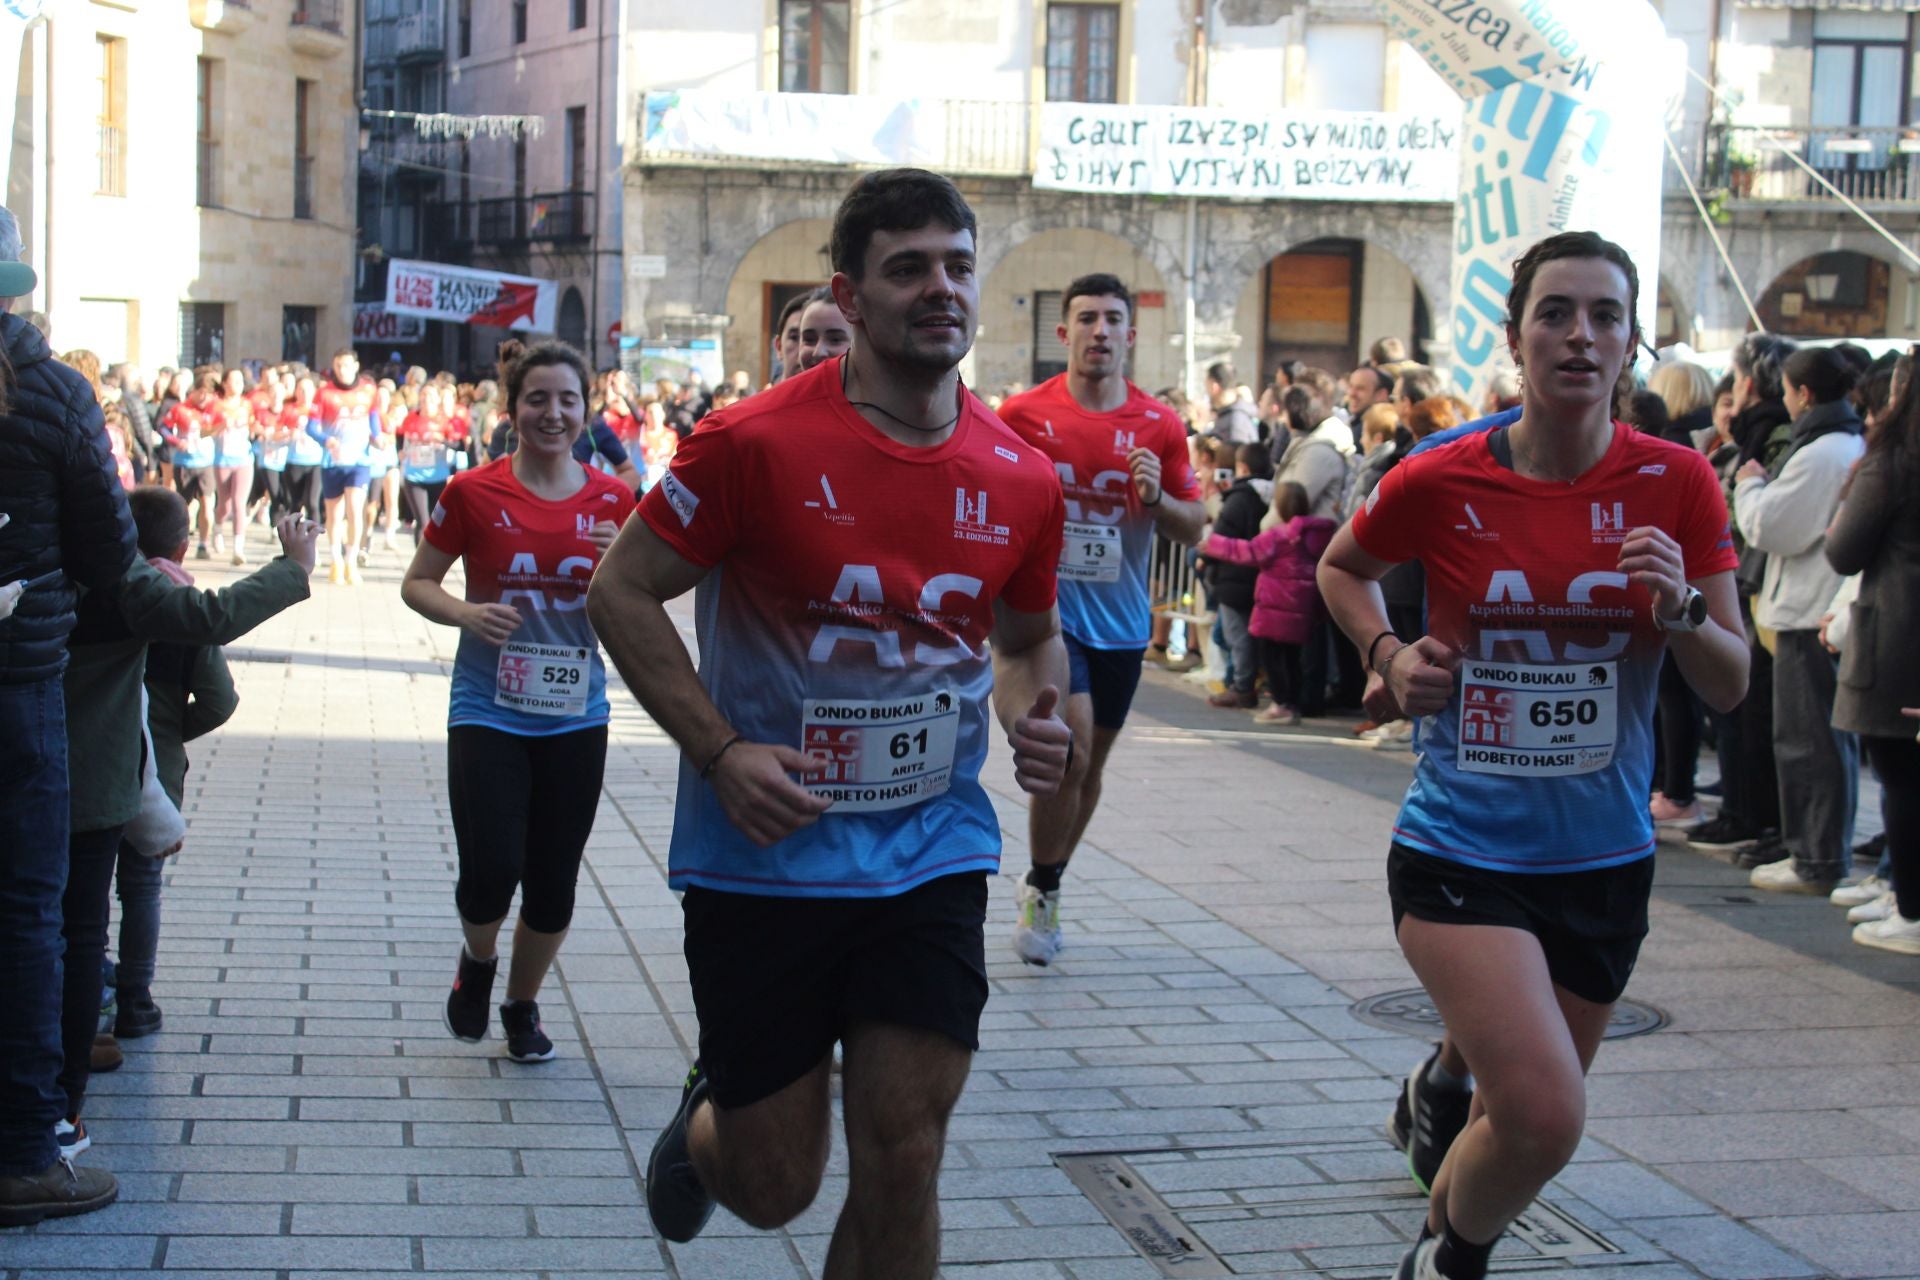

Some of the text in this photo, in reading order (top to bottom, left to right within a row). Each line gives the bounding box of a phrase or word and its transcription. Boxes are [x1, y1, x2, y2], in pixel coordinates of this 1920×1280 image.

[1547, 174, 1579, 232] Ainhize
[1083, 543, 1105, 557] 13
[807, 564, 984, 668] AS
[1469, 603, 1635, 619] Azpeitiko Sansilbestrie
[1480, 570, 1632, 662] AS
[507, 644, 571, 658] ONDO BUKAU
[542, 666, 580, 684] 529
[1472, 667, 1518, 683] ONDO
[1521, 672, 1576, 685] BUKAU
[500, 692, 539, 707] HOBETO
[814, 702, 924, 720] ONDO BUKAU
[1529, 699, 1598, 728] 650
[889, 728, 928, 760] 61
[1551, 734, 1576, 744] ANE
[1465, 750, 1574, 767] HOBETO HASI!
[891, 762, 925, 777] ARITZ
[879, 783, 917, 800] HASI!
